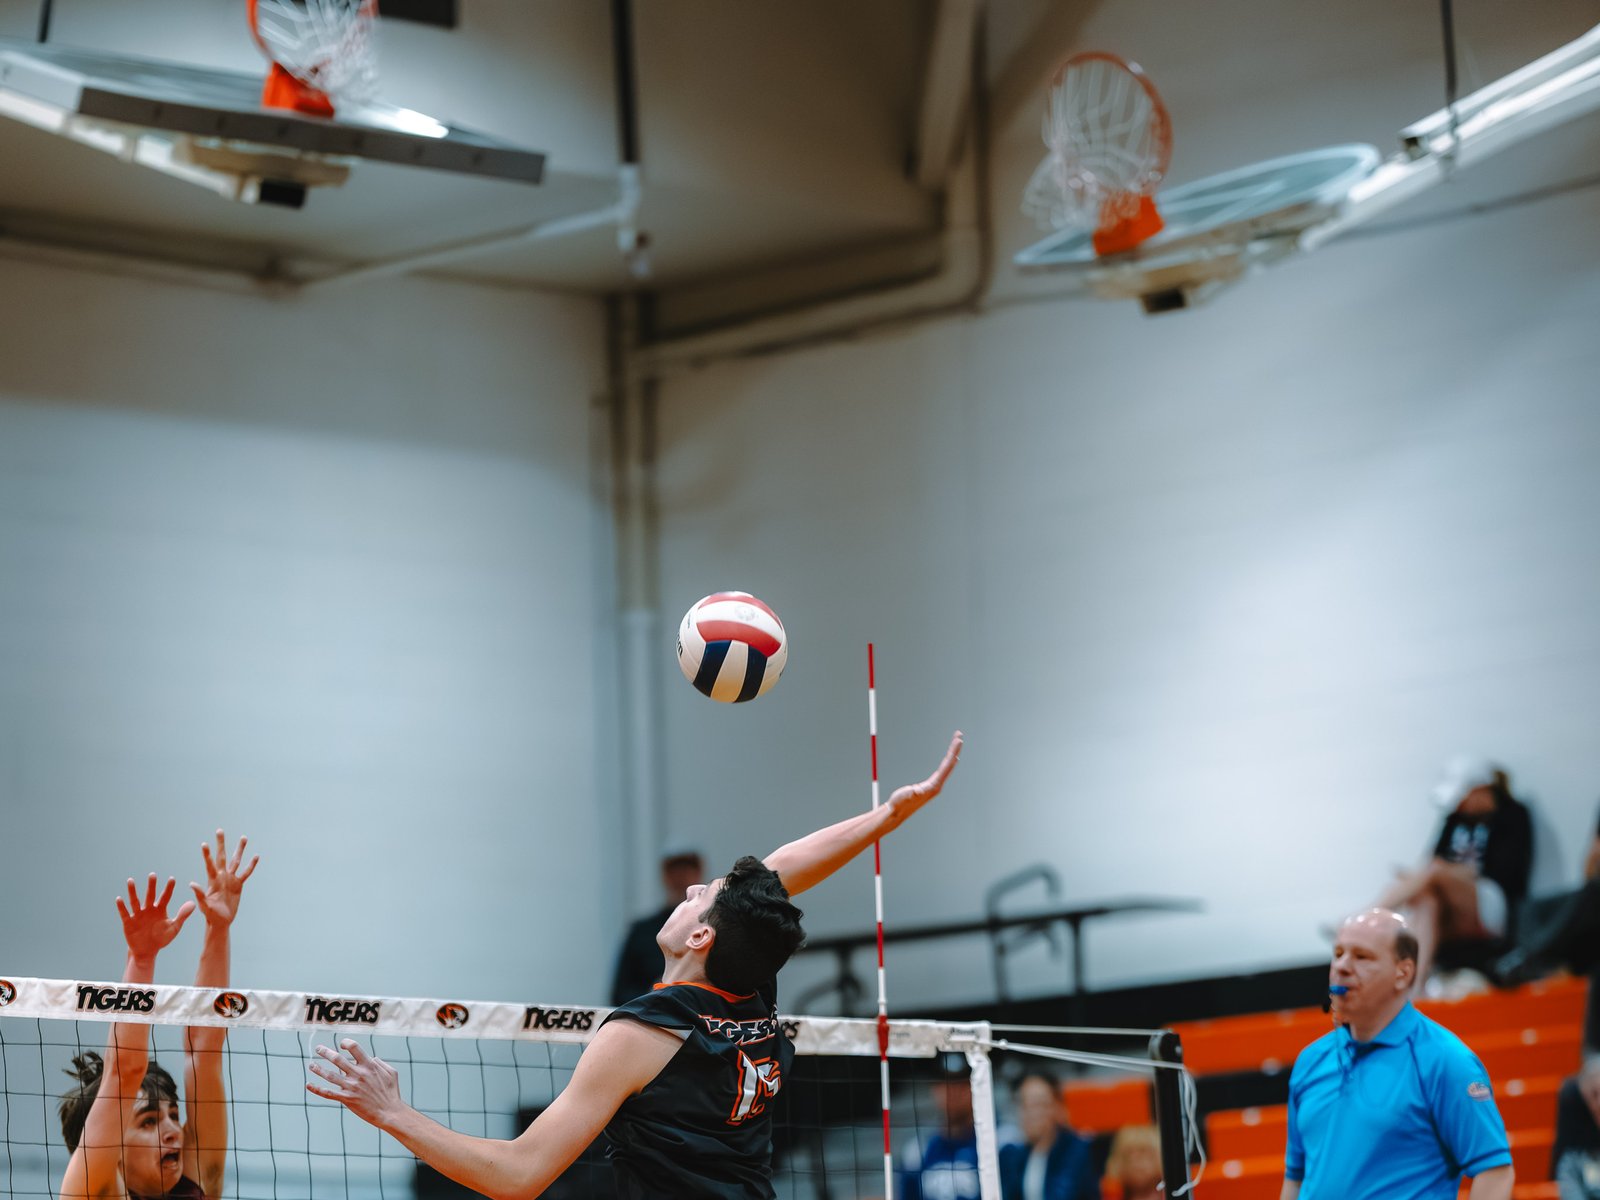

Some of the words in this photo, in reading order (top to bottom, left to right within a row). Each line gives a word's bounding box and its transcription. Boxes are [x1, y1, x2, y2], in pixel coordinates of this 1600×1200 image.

[76, 984, 157, 1014] TIGERS
[304, 996, 381, 1024] TIGERS
[522, 1006, 597, 1032] TIGERS
